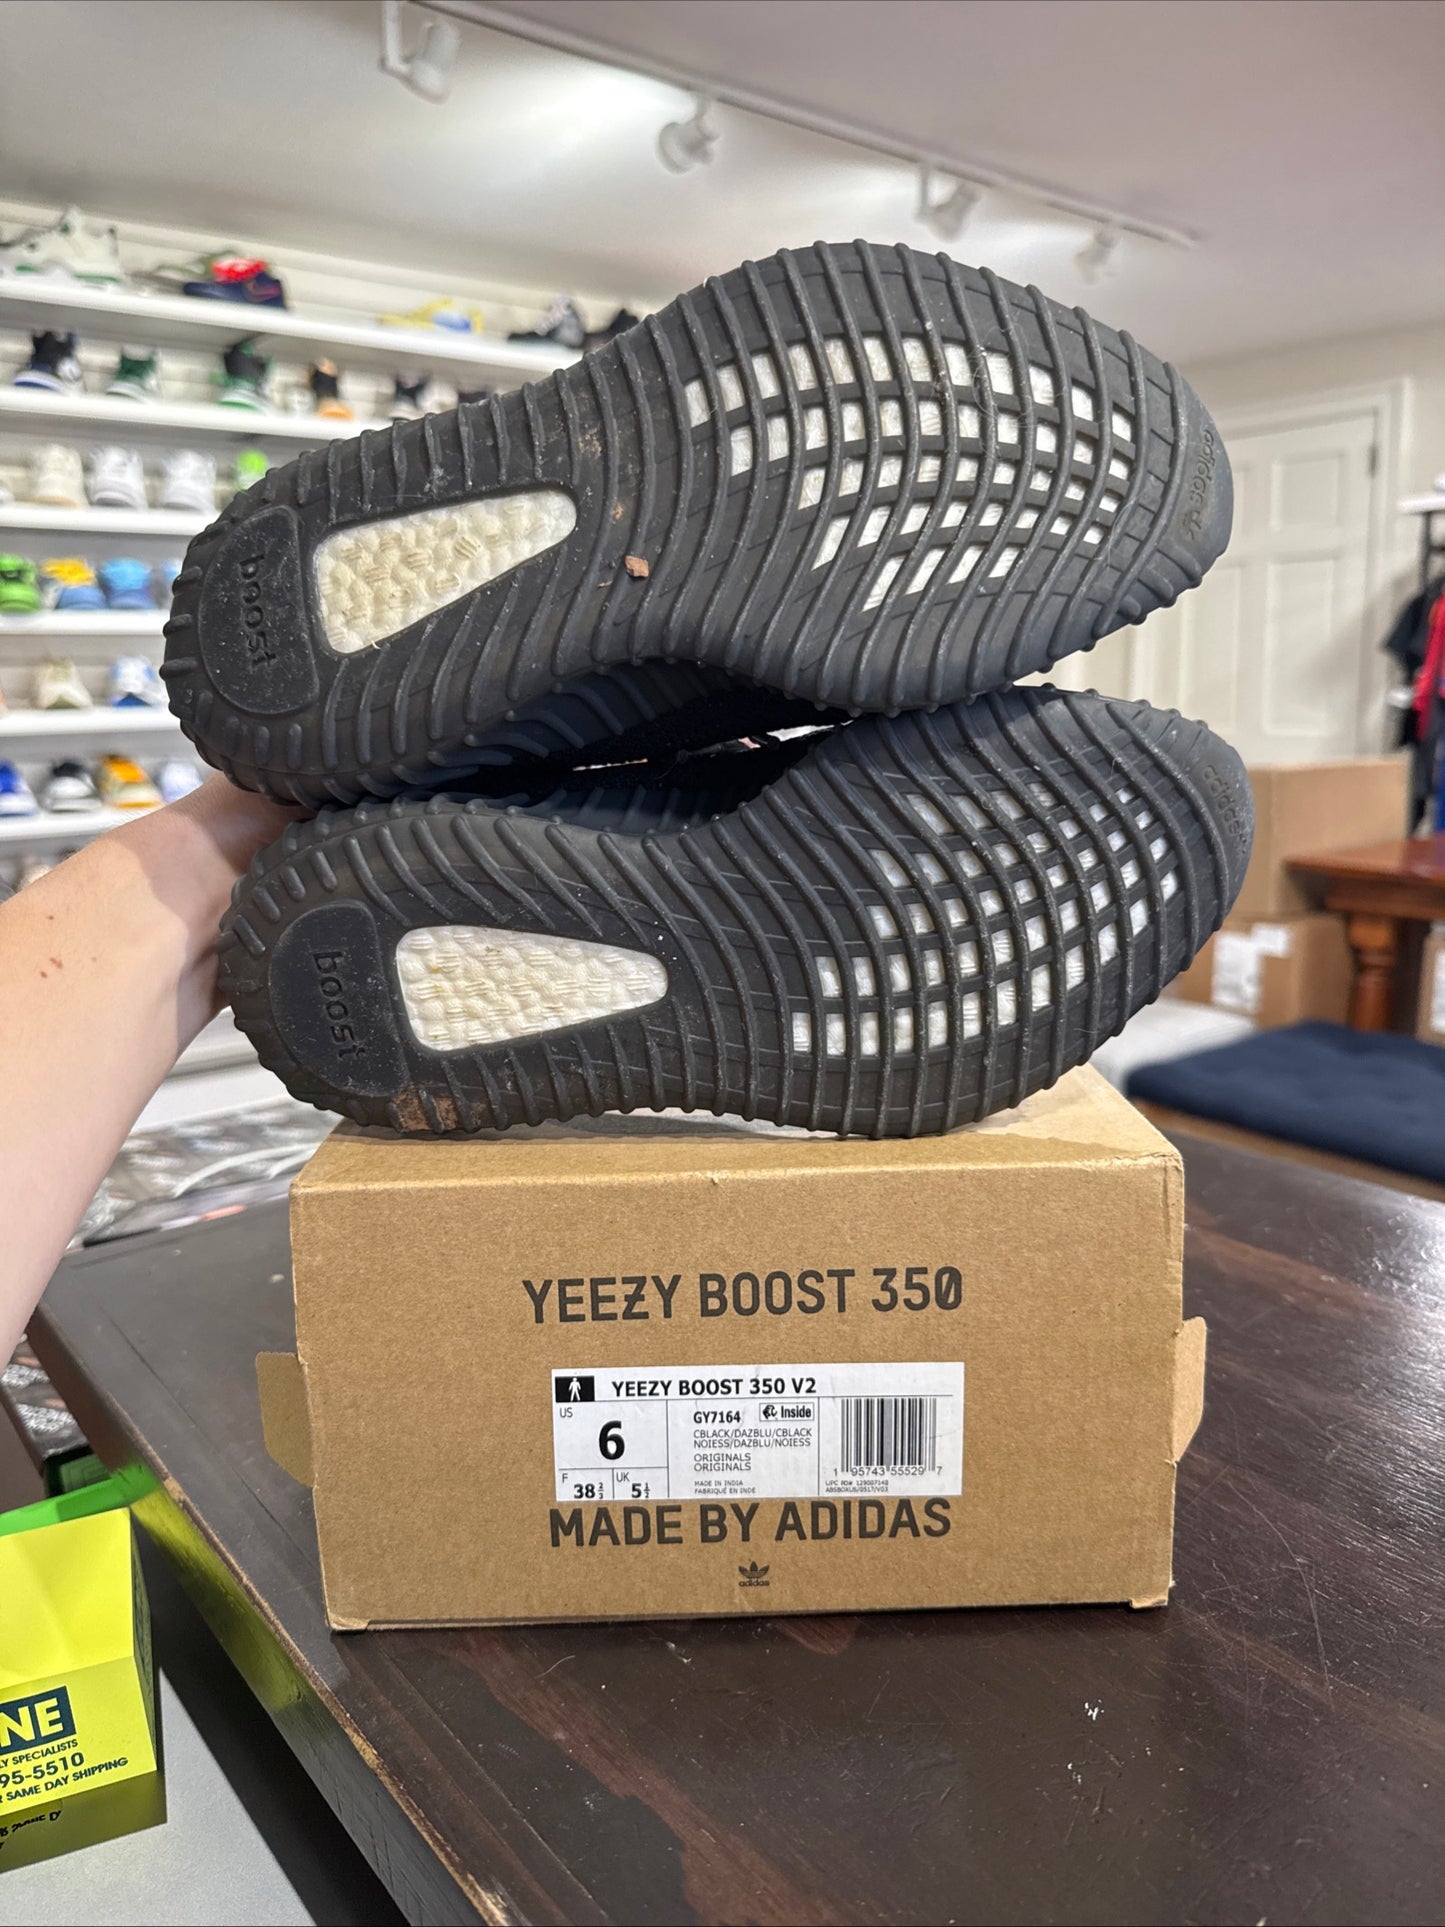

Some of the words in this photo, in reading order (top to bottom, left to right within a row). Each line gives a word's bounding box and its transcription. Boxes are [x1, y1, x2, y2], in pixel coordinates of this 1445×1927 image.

[240, 554, 277, 667] boost
[313, 951, 366, 1058] boost
[699, 1269, 855, 1318] BOOST
[871, 1266, 963, 1312] 350
[611, 1380, 672, 1397] YEEZY
[678, 1379, 743, 1396] BOOST
[749, 1378, 786, 1395] 350
[792, 1377, 817, 1394] V2
[559, 1407, 573, 1418] US
[693, 1410, 741, 1424] GY7164
[780, 1404, 812, 1419] Inside
[598, 1420, 625, 1460] 6
[693, 1427, 813, 1439] CBLACK/DAZBLU/CBLACK
[693, 1437, 812, 1449] NOIESS/DAZBLU/NOIESS
[693, 1453, 752, 1463] ORIGINALS
[693, 1462, 752, 1472] ORIGINALS
[833, 1467, 838, 1477] 1
[850, 1466, 886, 1477] 95743
[890, 1465, 925, 1477] 55529
[936, 1466, 943, 1476] 7
[561, 1473, 568, 1483] F
[616, 1472, 630, 1482] UK
[549, 1505, 683, 1547] MADE
[700, 1502, 760, 1544] BY
[775, 1498, 951, 1541] ADIDAS
[12, 1738, 78, 1765] SPECIALISTS
[6, 1784, 41, 1801] SAME
[44, 1774, 69, 1791] DAY
[72, 1756, 129, 1782] SHIPPING
